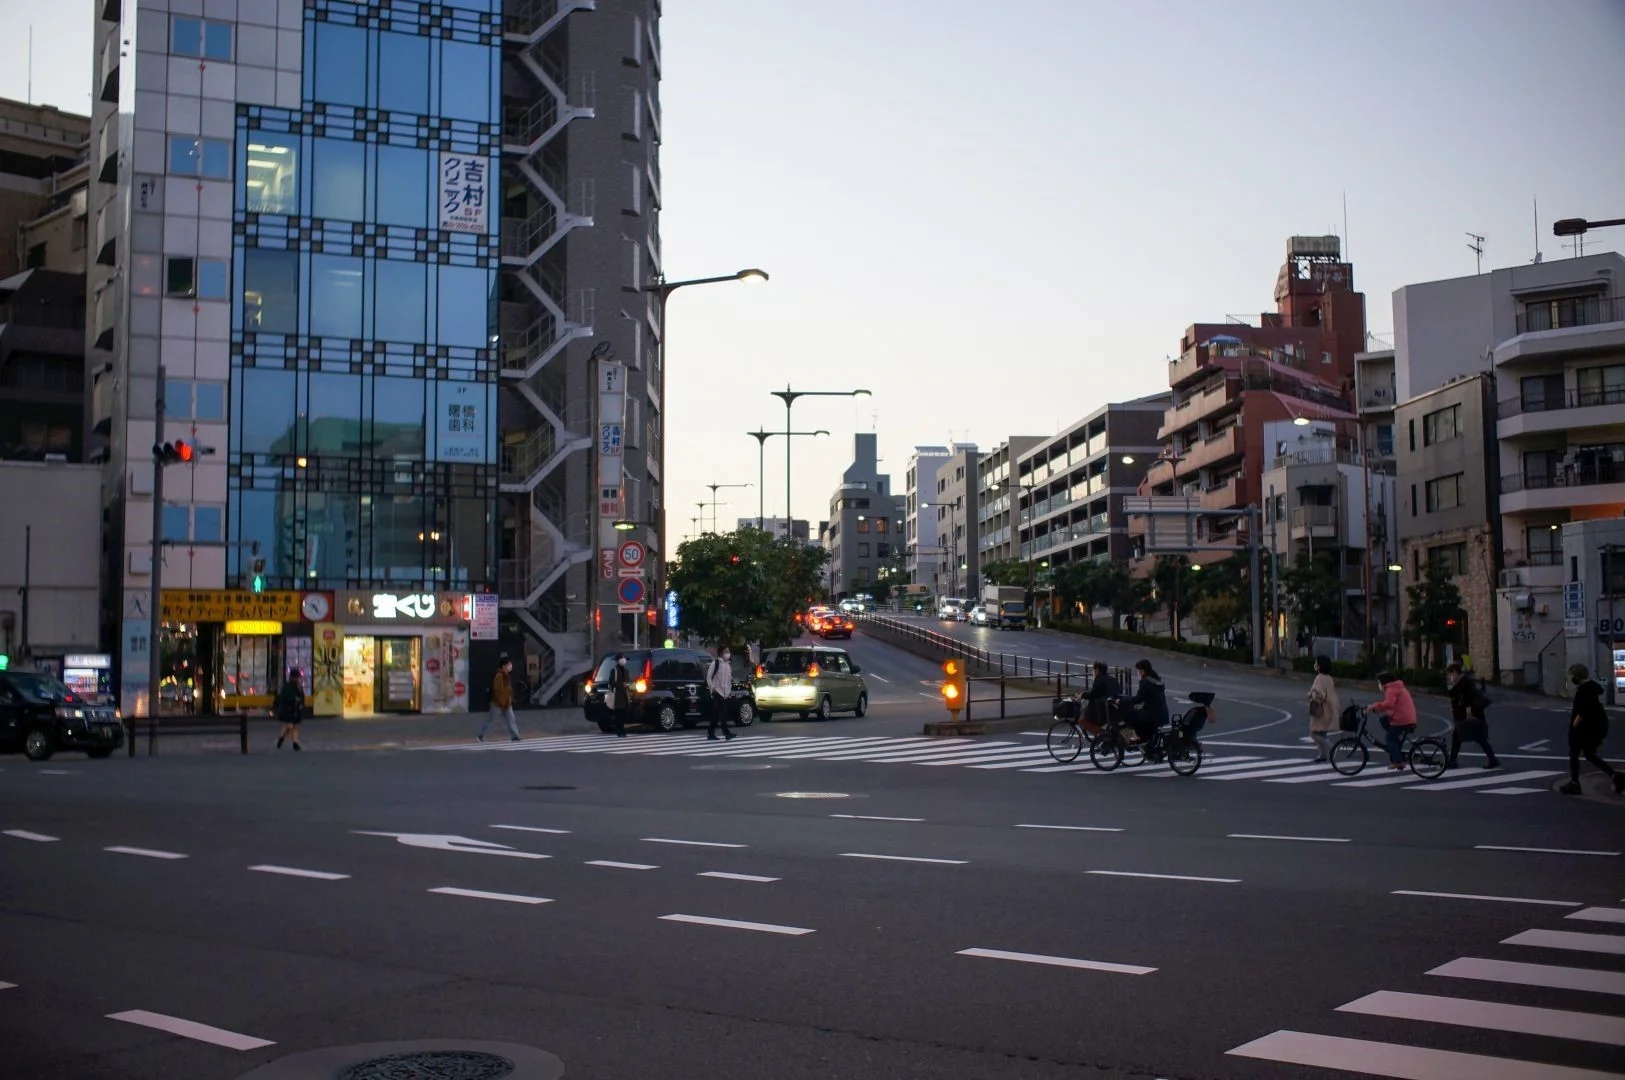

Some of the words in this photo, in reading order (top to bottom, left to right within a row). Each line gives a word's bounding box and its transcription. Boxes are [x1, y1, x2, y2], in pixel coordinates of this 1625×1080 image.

[444, 158, 461, 213] クリニック
[462, 160, 485, 207] 吉村
[624, 548, 639, 561] 50
